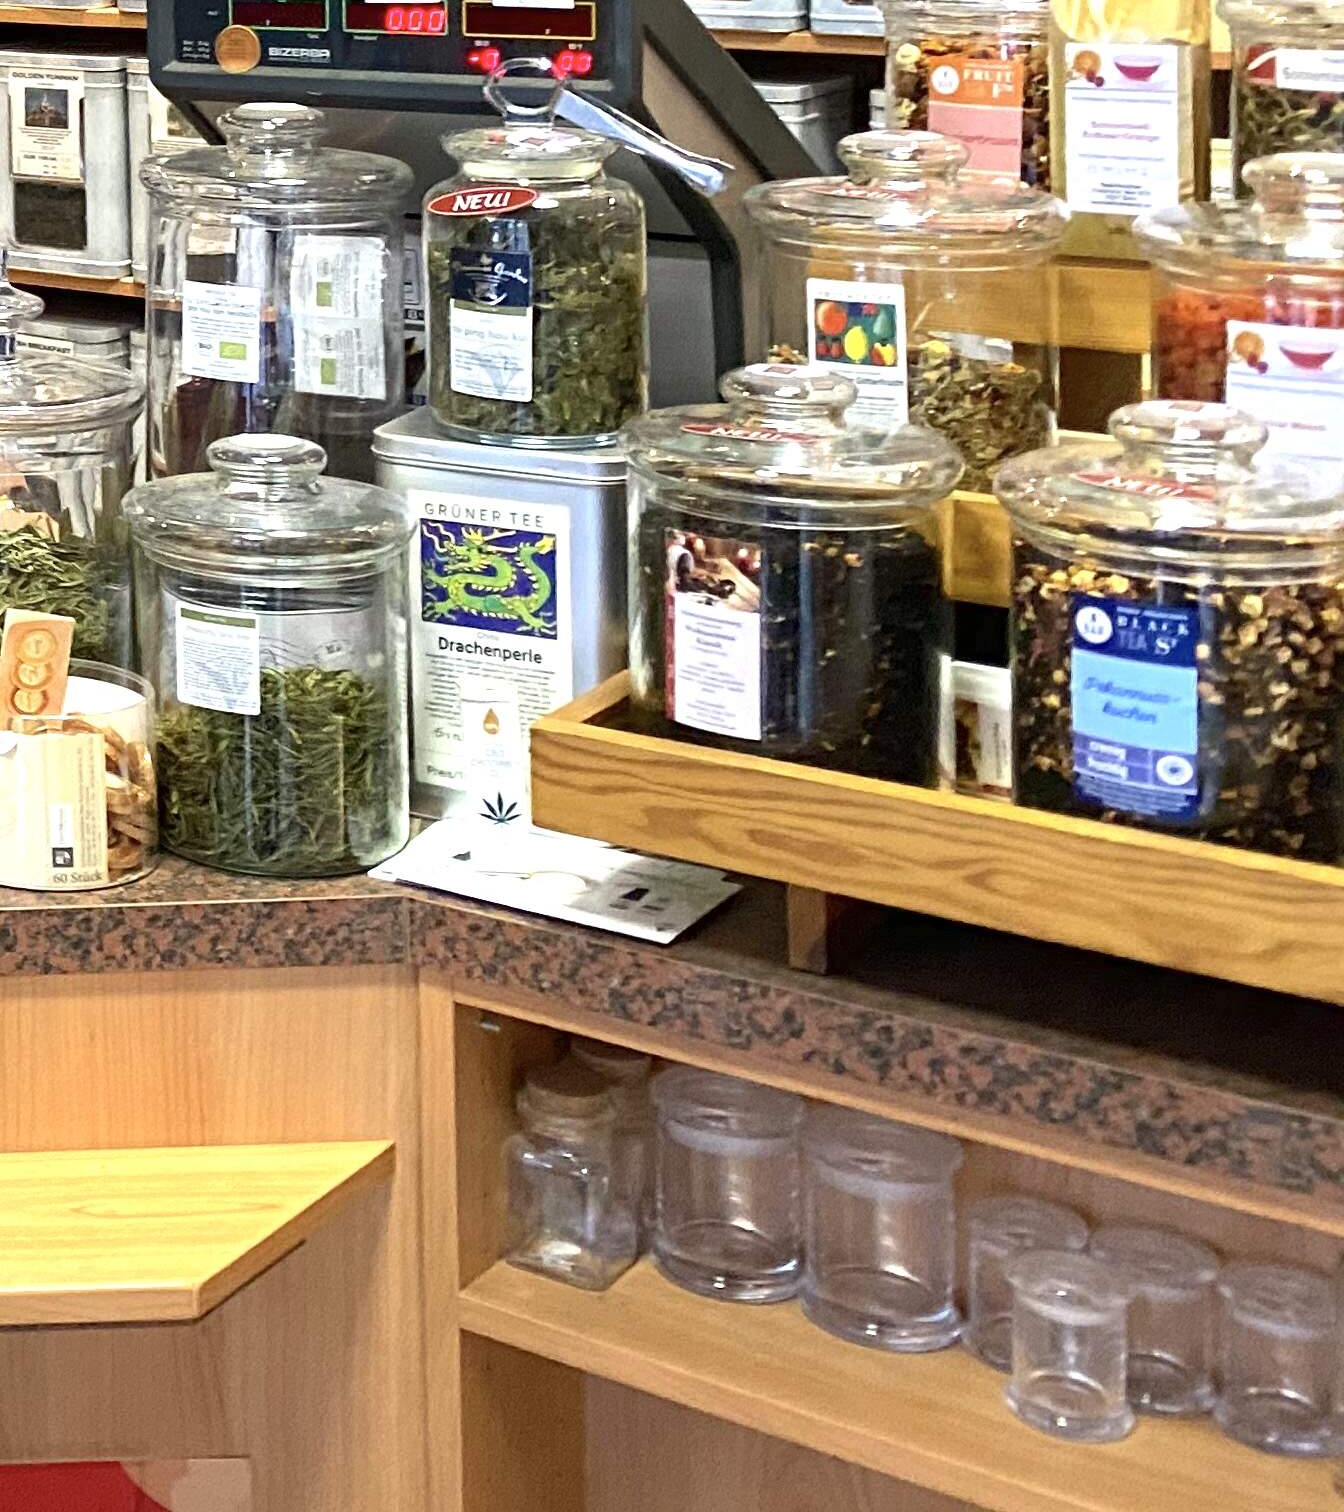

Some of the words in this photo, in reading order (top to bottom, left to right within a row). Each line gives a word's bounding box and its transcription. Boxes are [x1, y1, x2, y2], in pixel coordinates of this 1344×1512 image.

[268, 47, 332, 60] BIZERBA
[963, 66, 1013, 83] FRUIT
[424, 502, 502, 521] GRÜNER
[509, 511, 545, 528] TEE
[1116, 615, 1190, 637] BLACK
[437, 635, 543, 664] Drachenperle
[52, 872, 69, 884] 60
[70, 871, 102, 884] Stück
